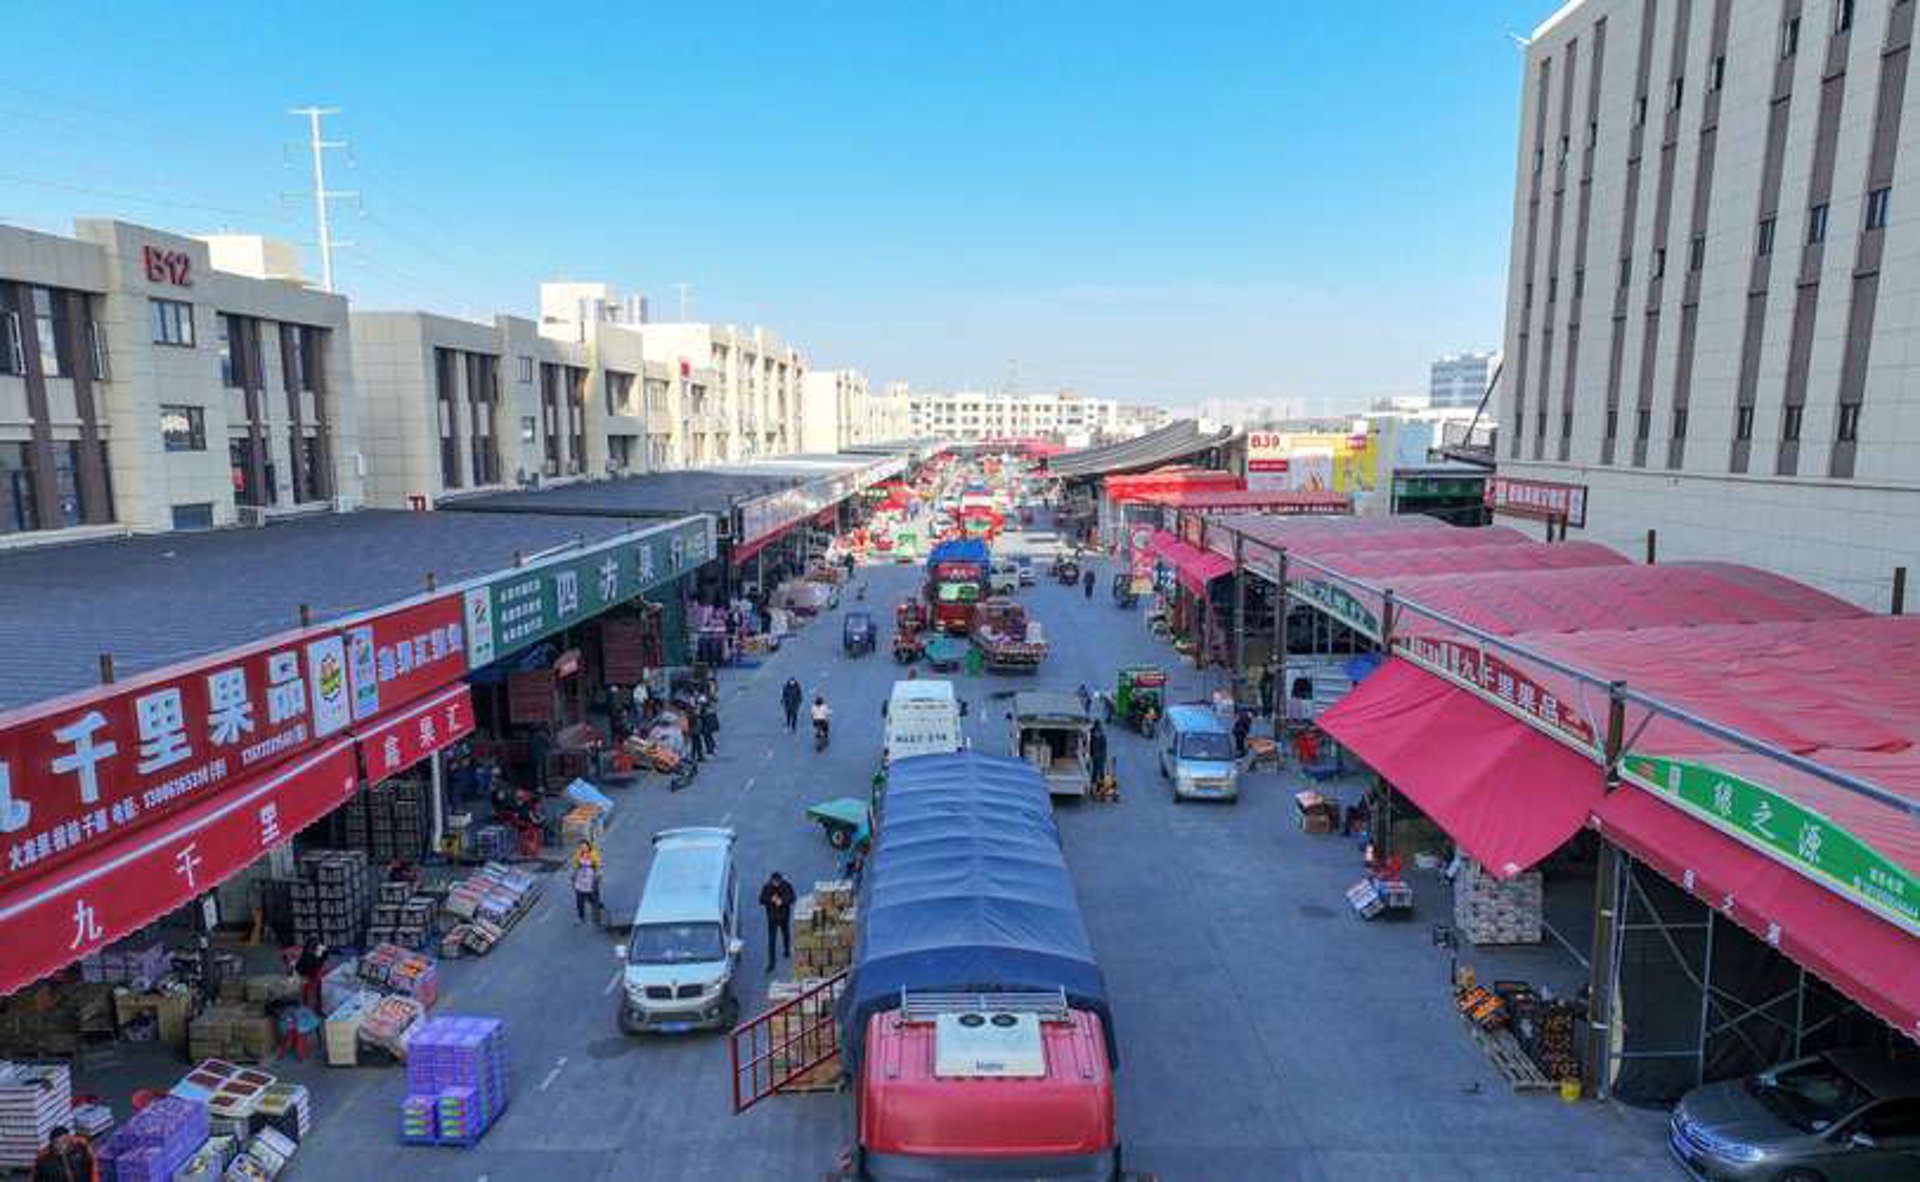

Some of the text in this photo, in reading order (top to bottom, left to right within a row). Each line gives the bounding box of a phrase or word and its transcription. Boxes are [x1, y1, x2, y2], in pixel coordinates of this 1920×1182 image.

[143, 245, 190, 287] B12
[1250, 434, 1280, 448] B39
[70, 802, 281, 950] 九千里
